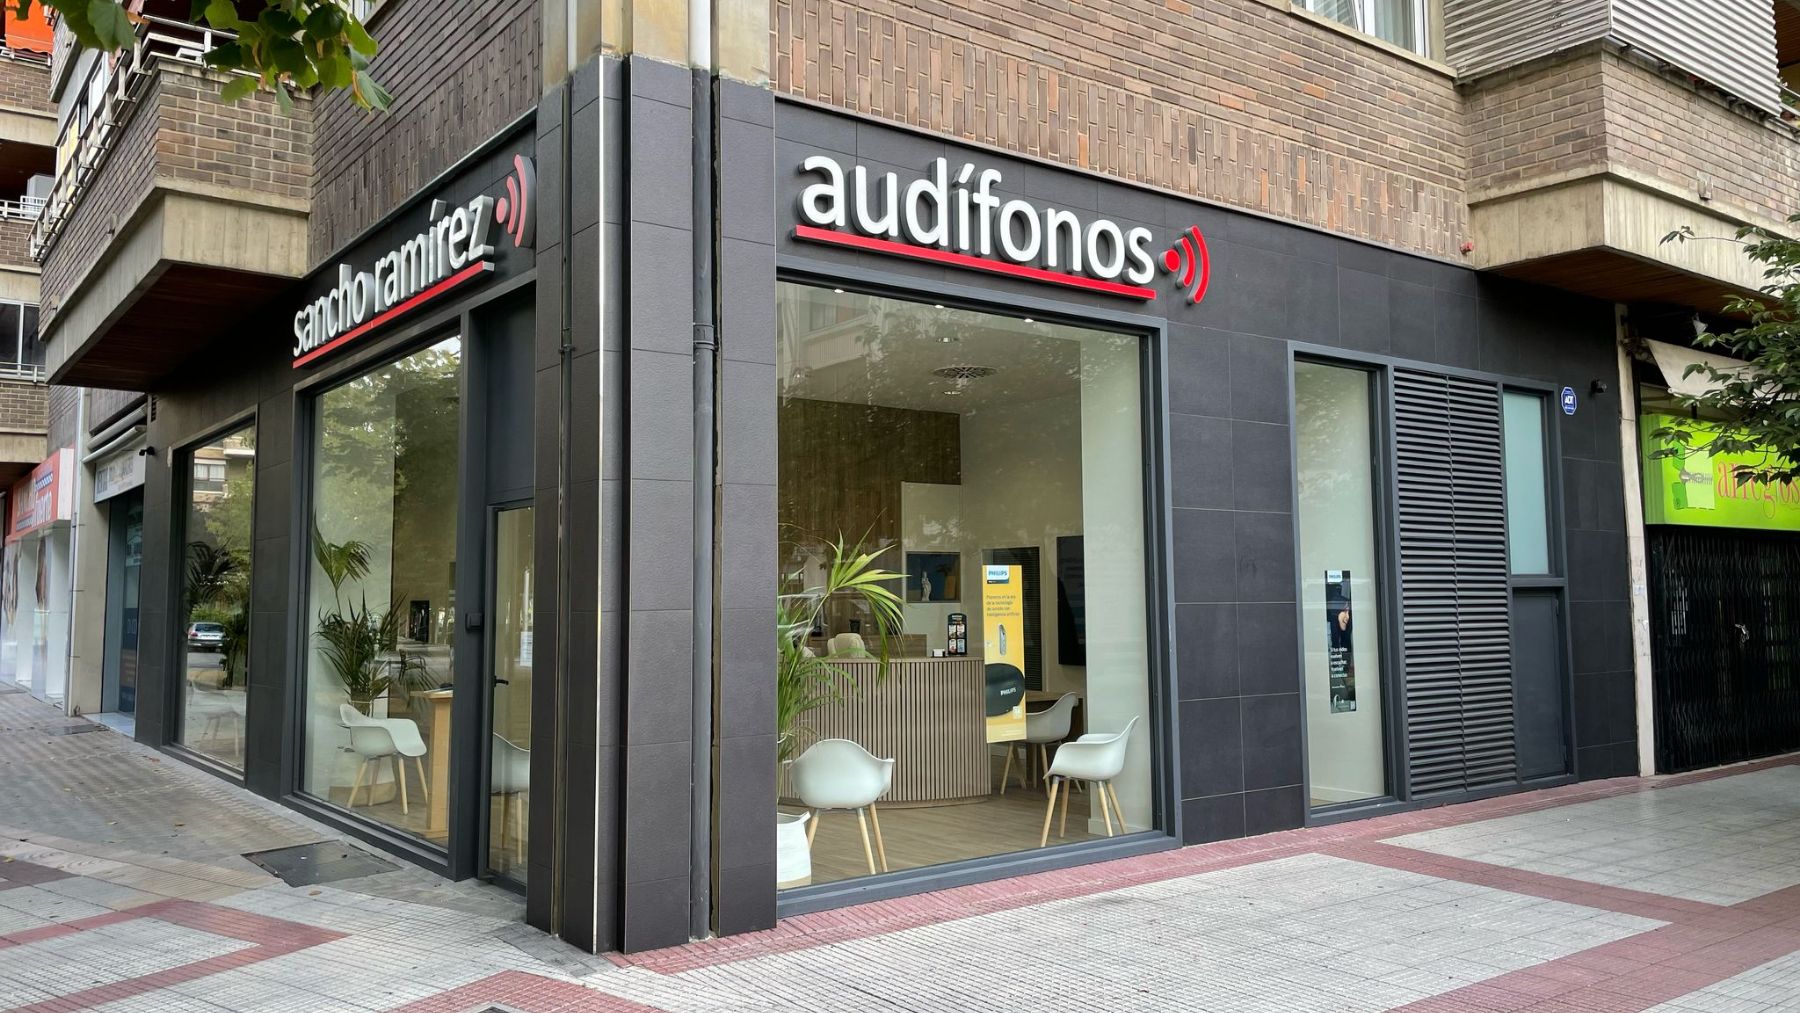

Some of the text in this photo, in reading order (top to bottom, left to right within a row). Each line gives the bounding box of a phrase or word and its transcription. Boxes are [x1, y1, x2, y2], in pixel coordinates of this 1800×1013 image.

[293, 194, 494, 357] sancho ramírez
[800, 155, 1155, 284] audífonos
[1000, 687, 1017, 696] PHILIPS
